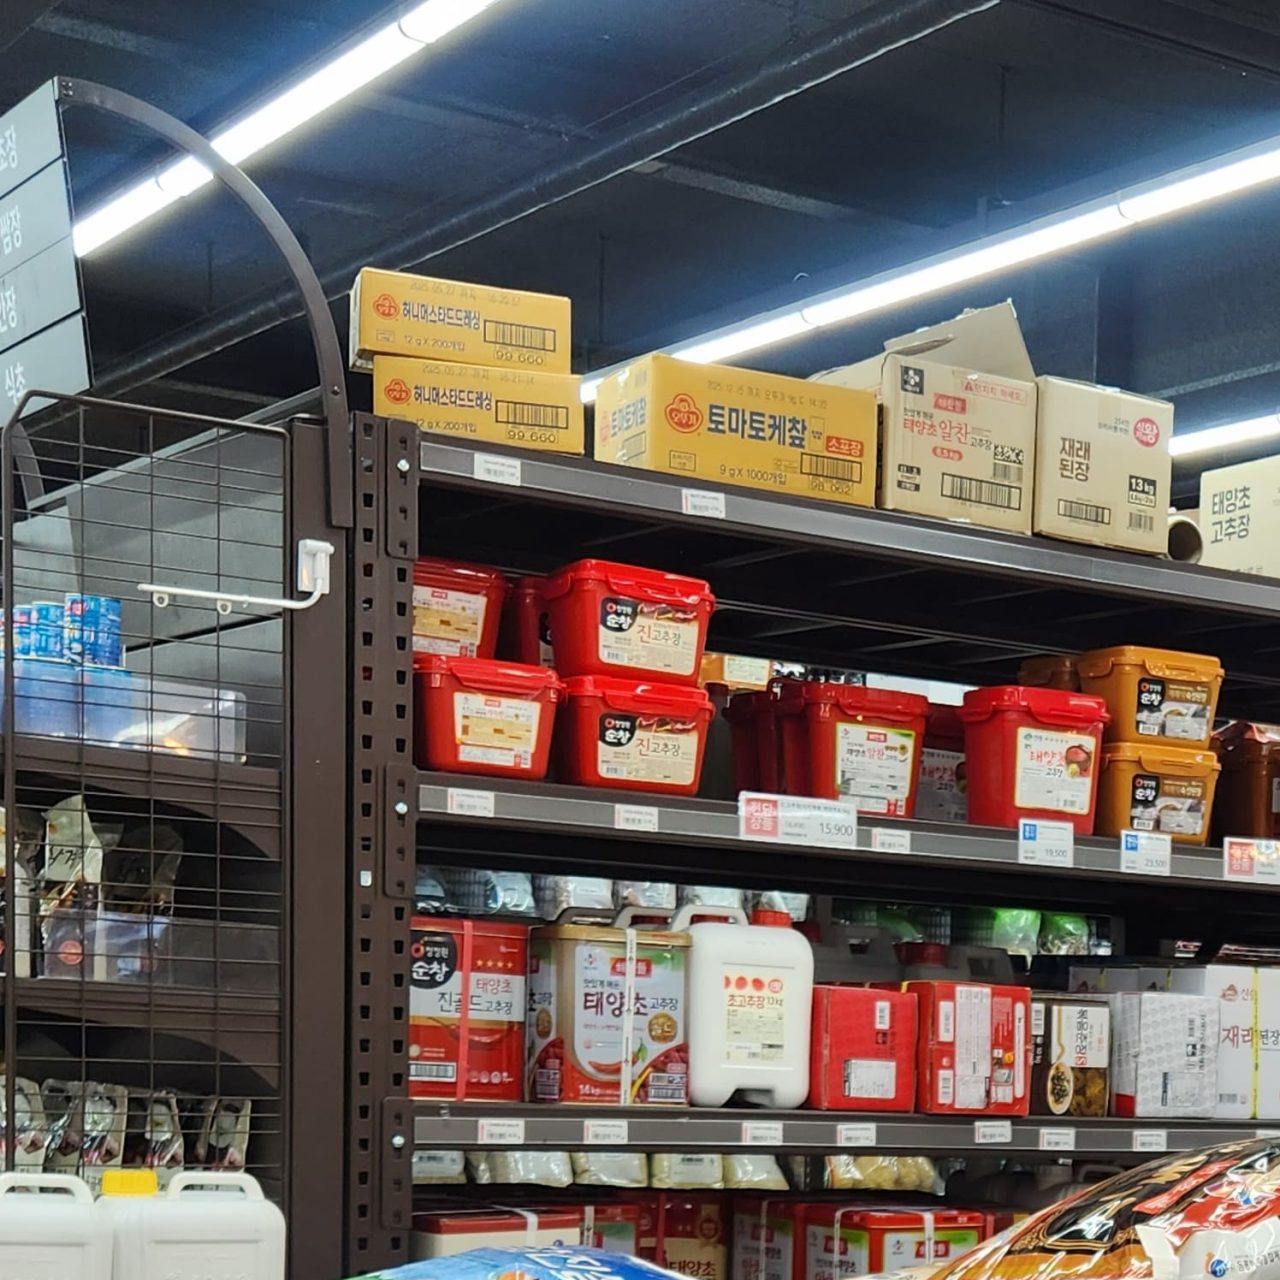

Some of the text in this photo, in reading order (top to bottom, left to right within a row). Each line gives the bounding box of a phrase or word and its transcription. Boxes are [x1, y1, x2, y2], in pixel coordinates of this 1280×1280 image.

[1060, 437, 1091, 461] 재래
[1059, 459, 1090, 482] 된장
[1212, 486, 1251, 515] 태양초
[1211, 516, 1250, 544] 고추장
[606, 614, 632, 630] 순창
[605, 729, 631, 744] 순창
[819, 823, 854, 837] 15,900
[412, 961, 450, 981] 순창
[476, 978, 512, 995] 태양초
[728, 994, 765, 1009] 초고추장
